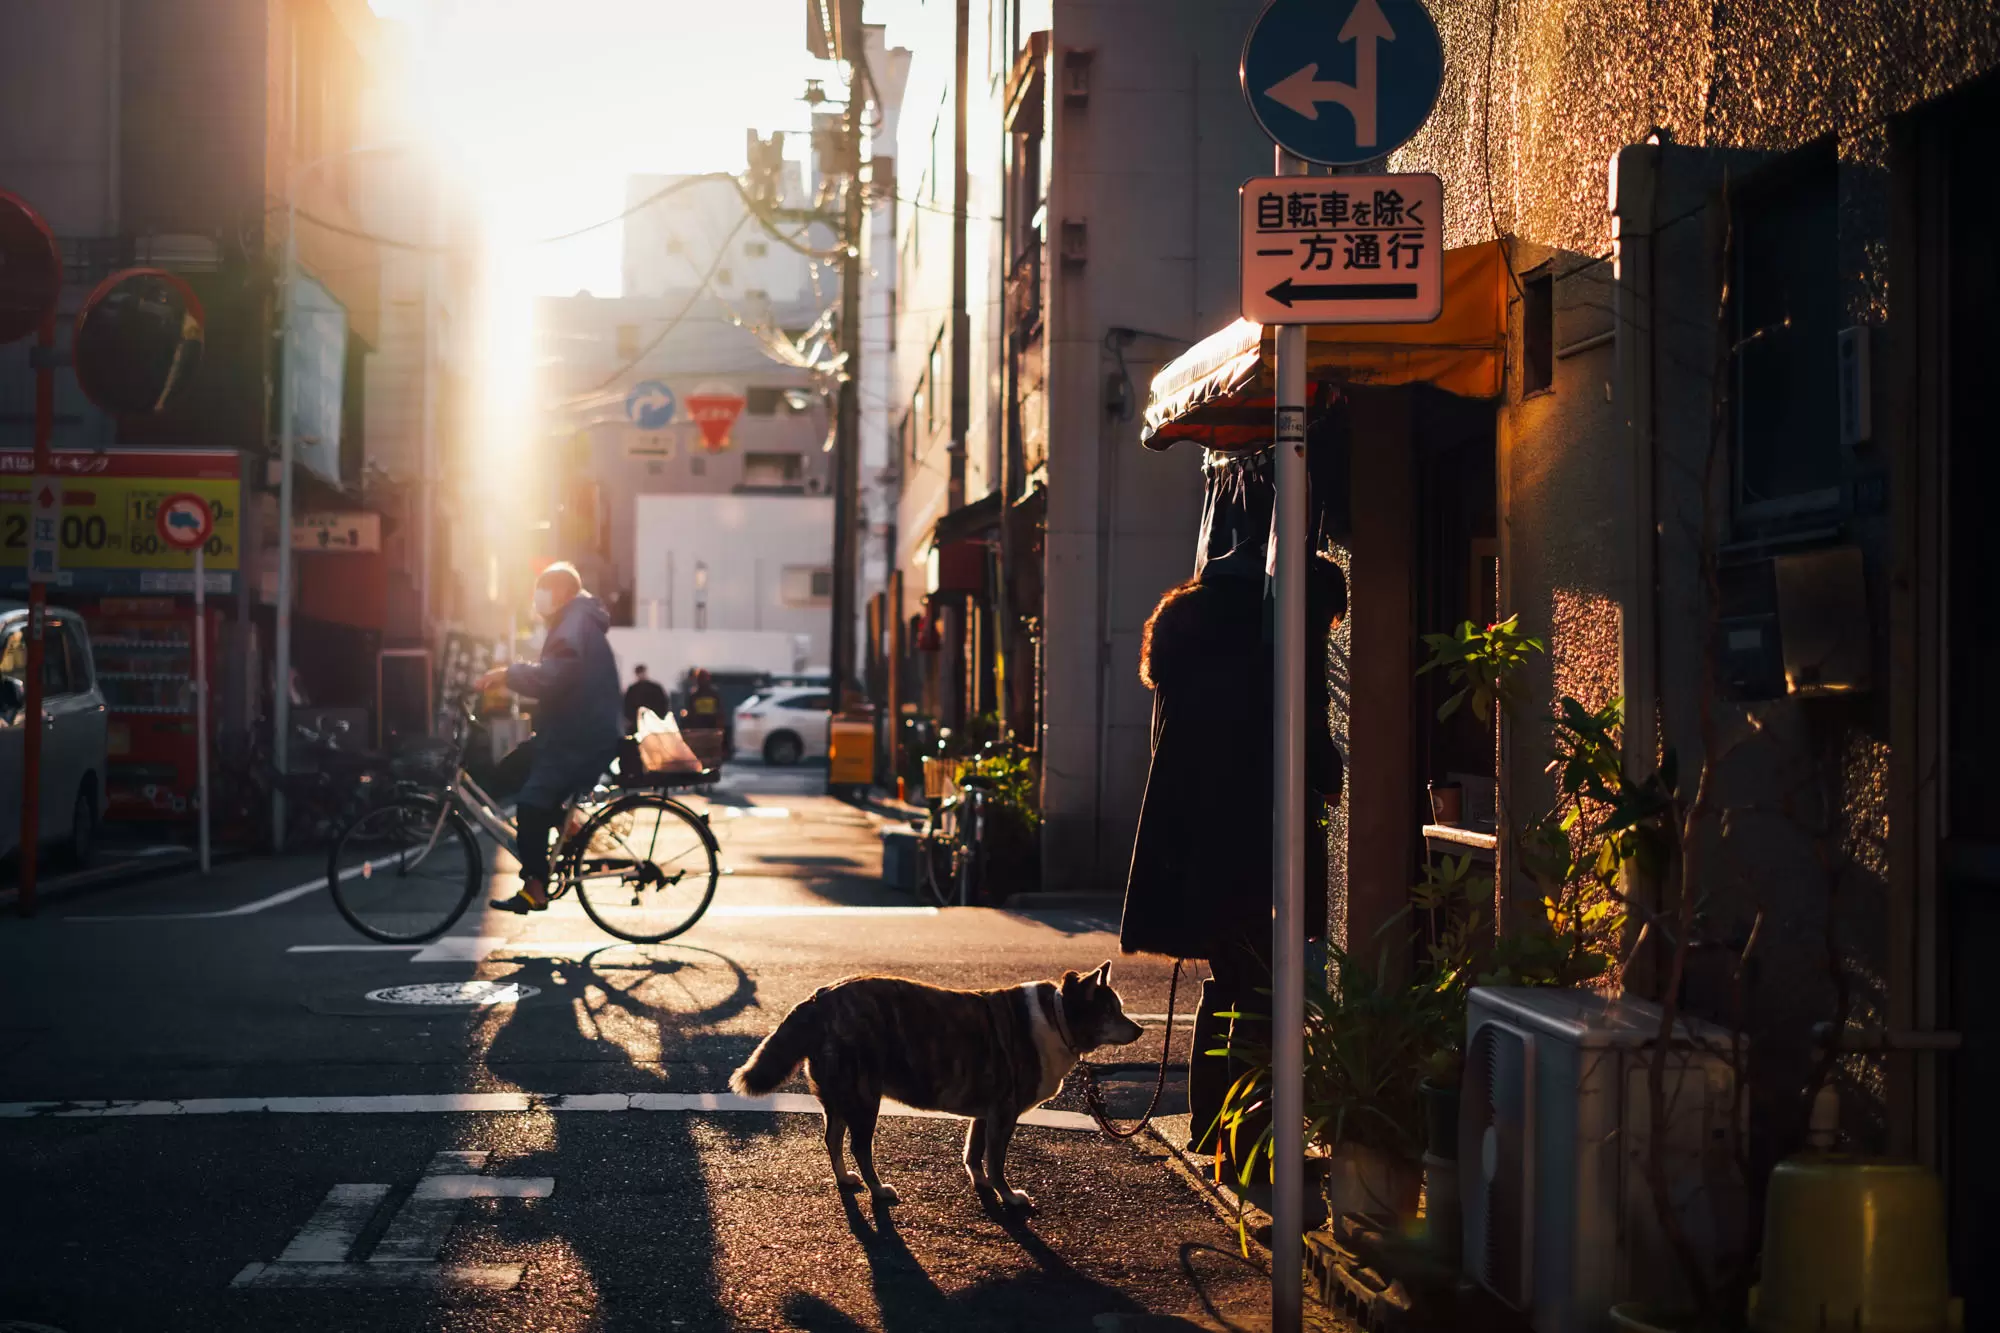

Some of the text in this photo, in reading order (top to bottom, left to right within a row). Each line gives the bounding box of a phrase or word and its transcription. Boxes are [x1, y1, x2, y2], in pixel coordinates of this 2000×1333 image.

[1257, 190, 1424, 228] 自転車を除く
[1256, 233, 1424, 271] 一方通行
